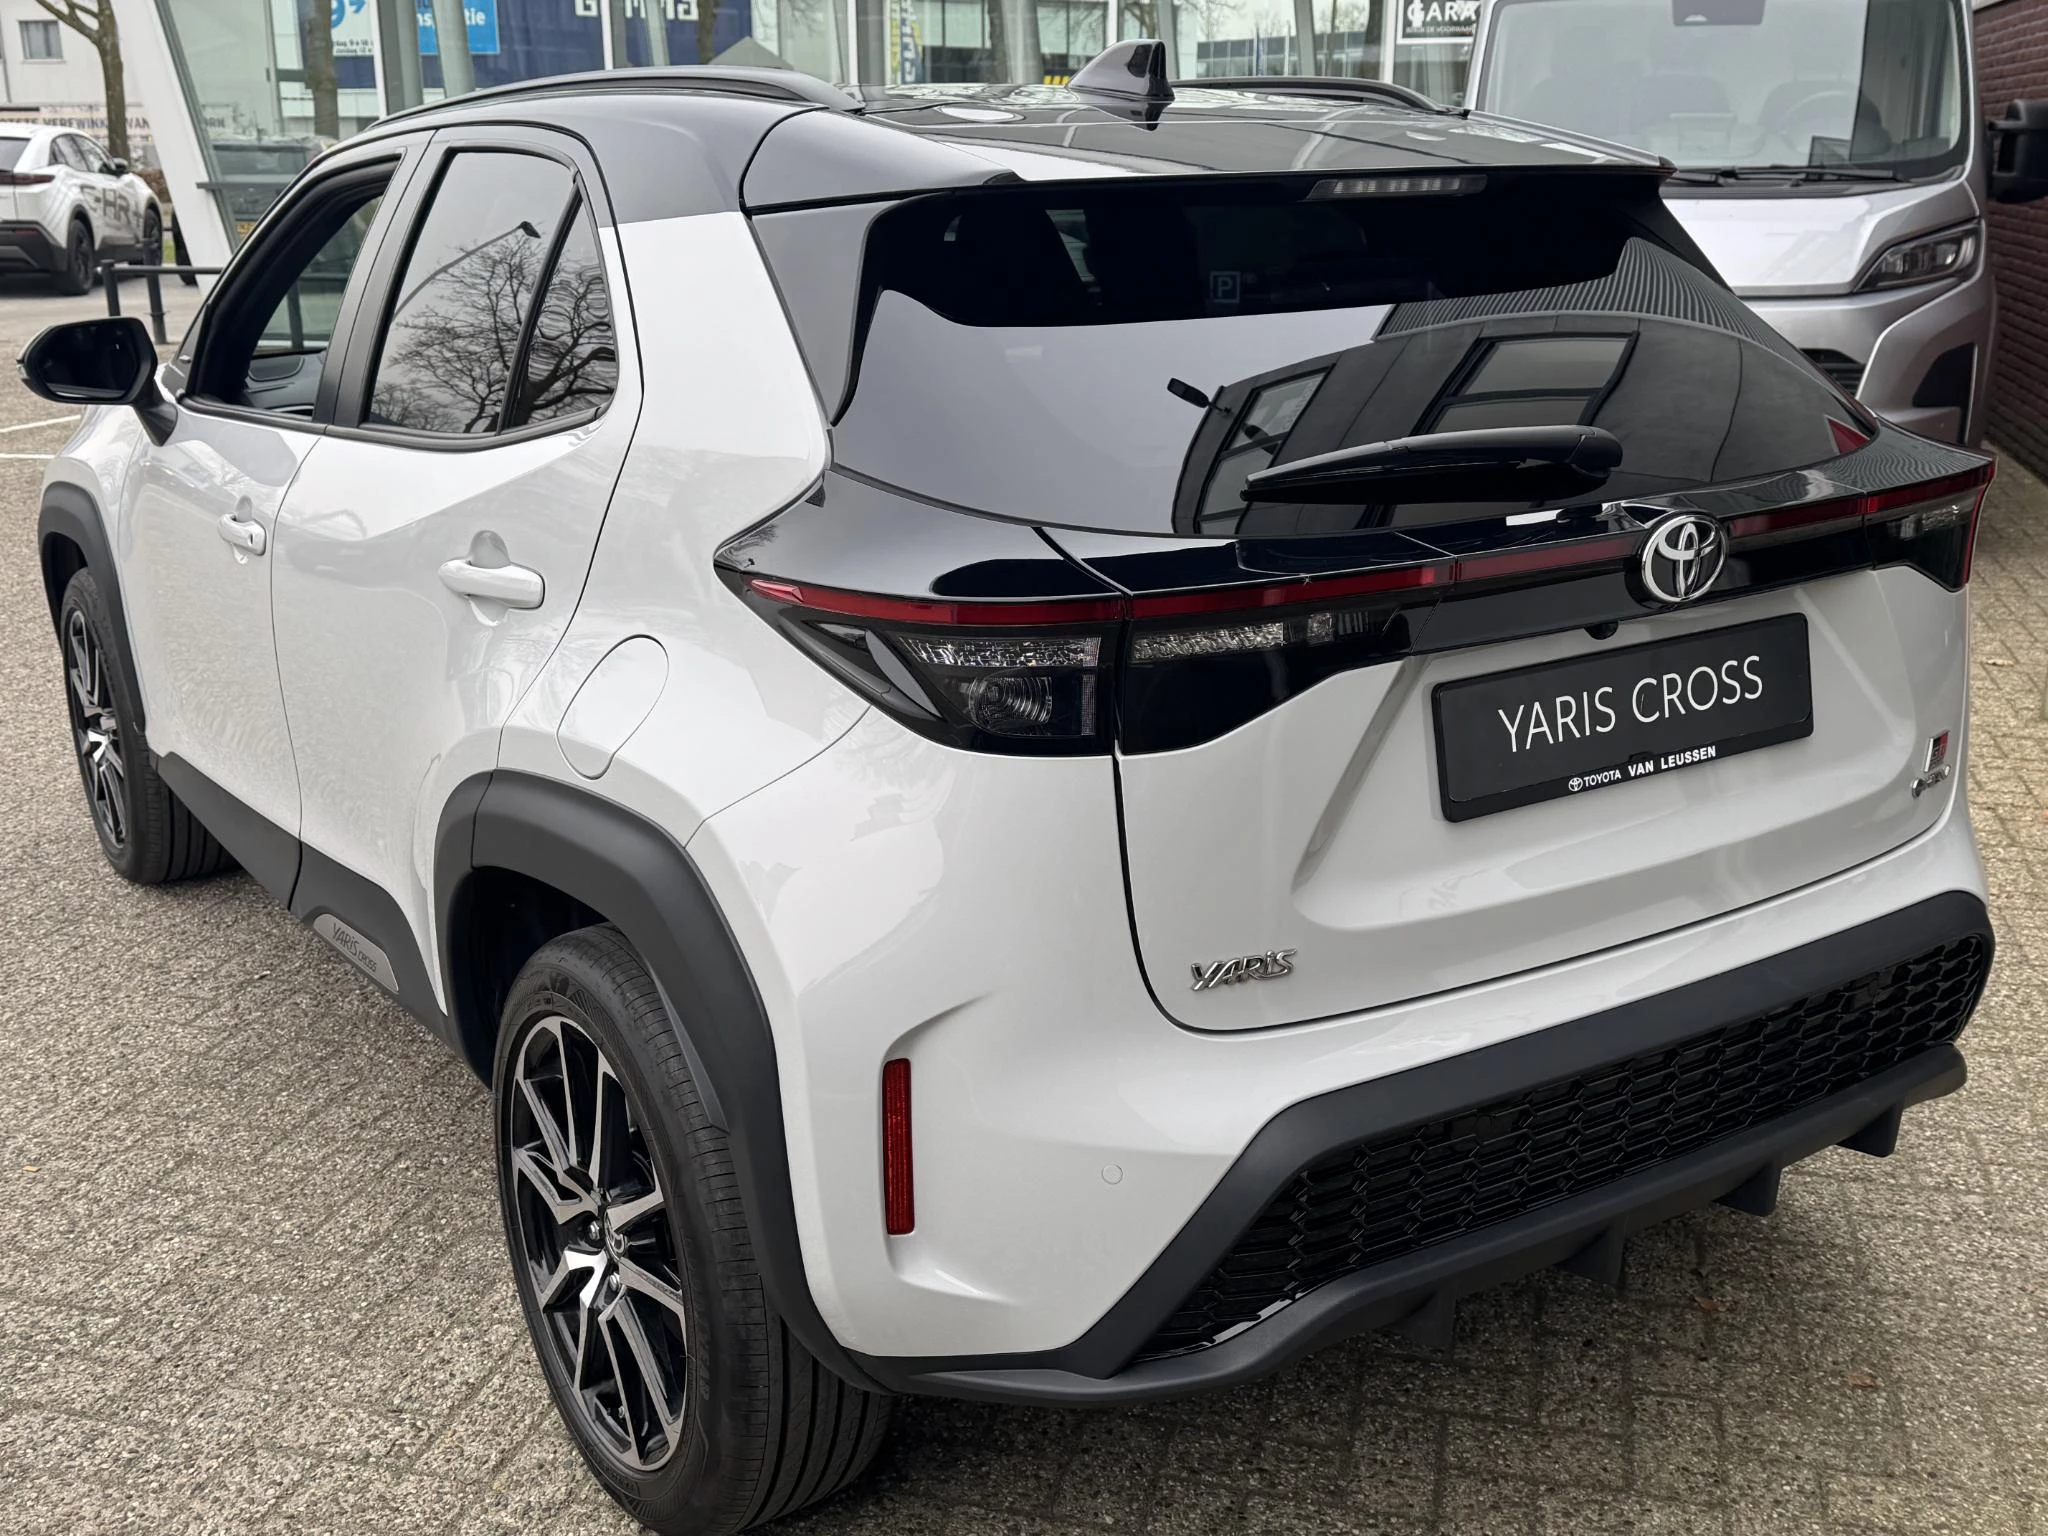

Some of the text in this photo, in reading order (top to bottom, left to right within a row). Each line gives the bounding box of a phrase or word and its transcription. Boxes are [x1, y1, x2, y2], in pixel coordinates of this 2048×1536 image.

[1497, 655, 1764, 753] YARIS CROSS
[1584, 745, 1716, 787] TOYOTA VAN LEUSSEN
